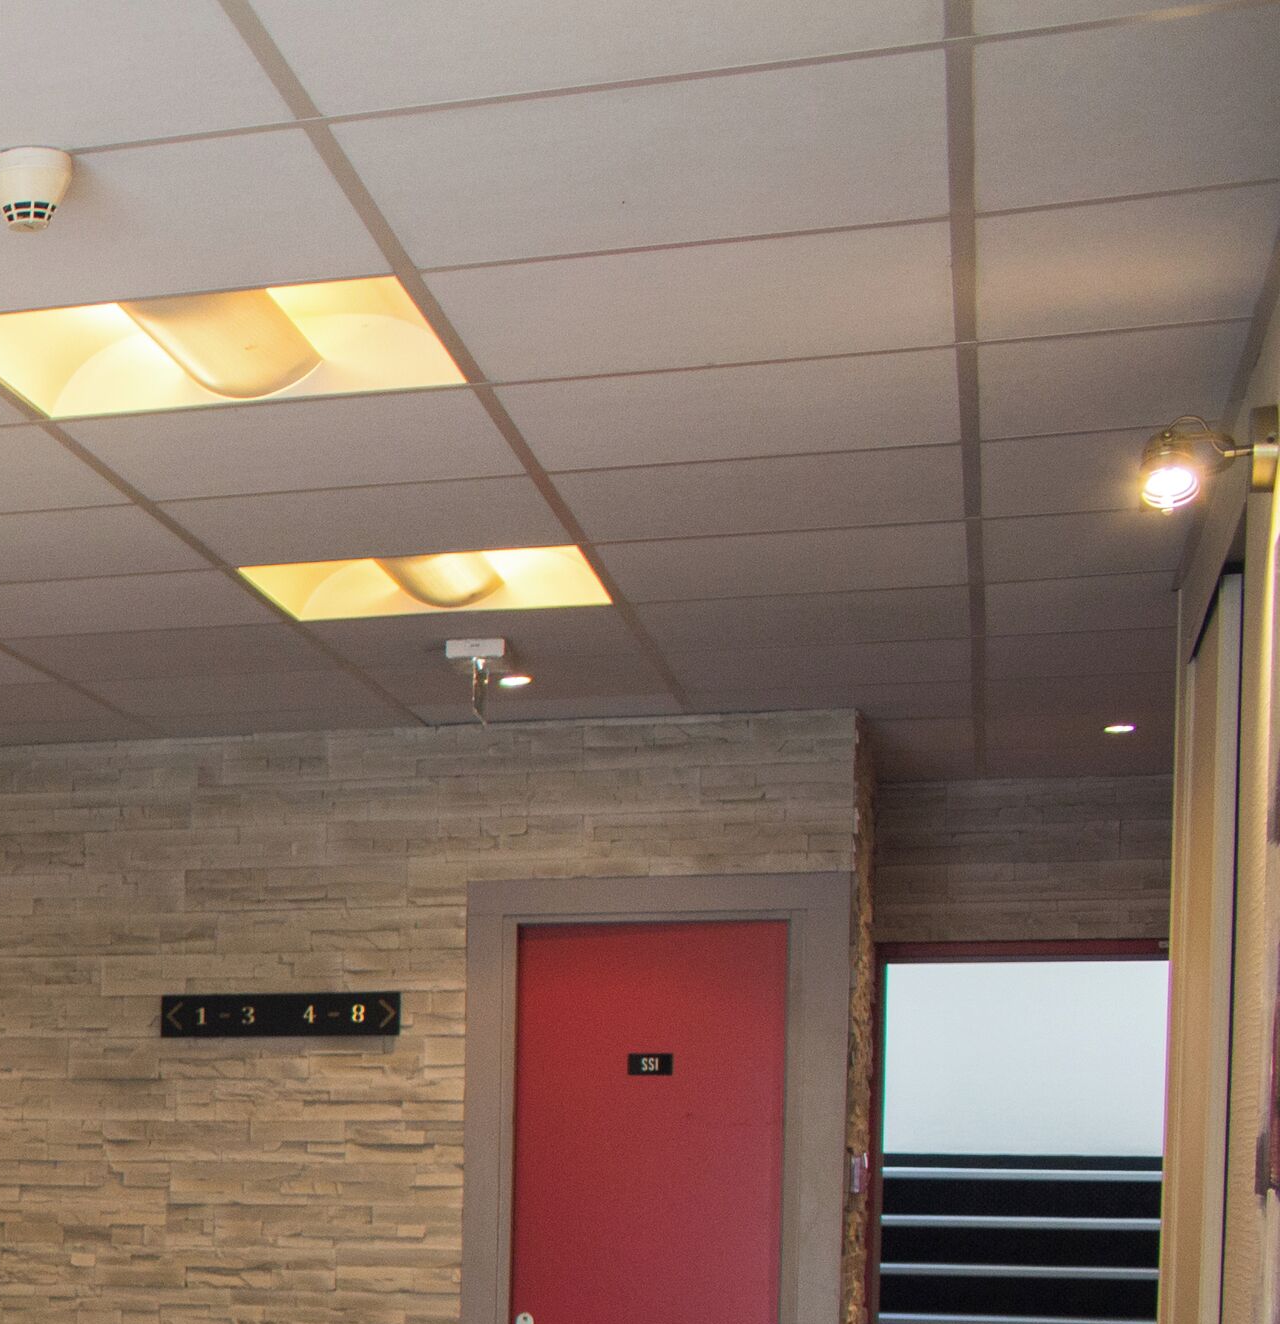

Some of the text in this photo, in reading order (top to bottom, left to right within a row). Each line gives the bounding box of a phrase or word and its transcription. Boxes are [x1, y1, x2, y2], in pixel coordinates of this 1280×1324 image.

[194, 1006, 208, 1025] 1
[240, 1006, 256, 1025] 3
[302, 1004, 317, 1024] 4
[350, 1003, 366, 1023] 8
[641, 1057, 659, 1072] SSI
